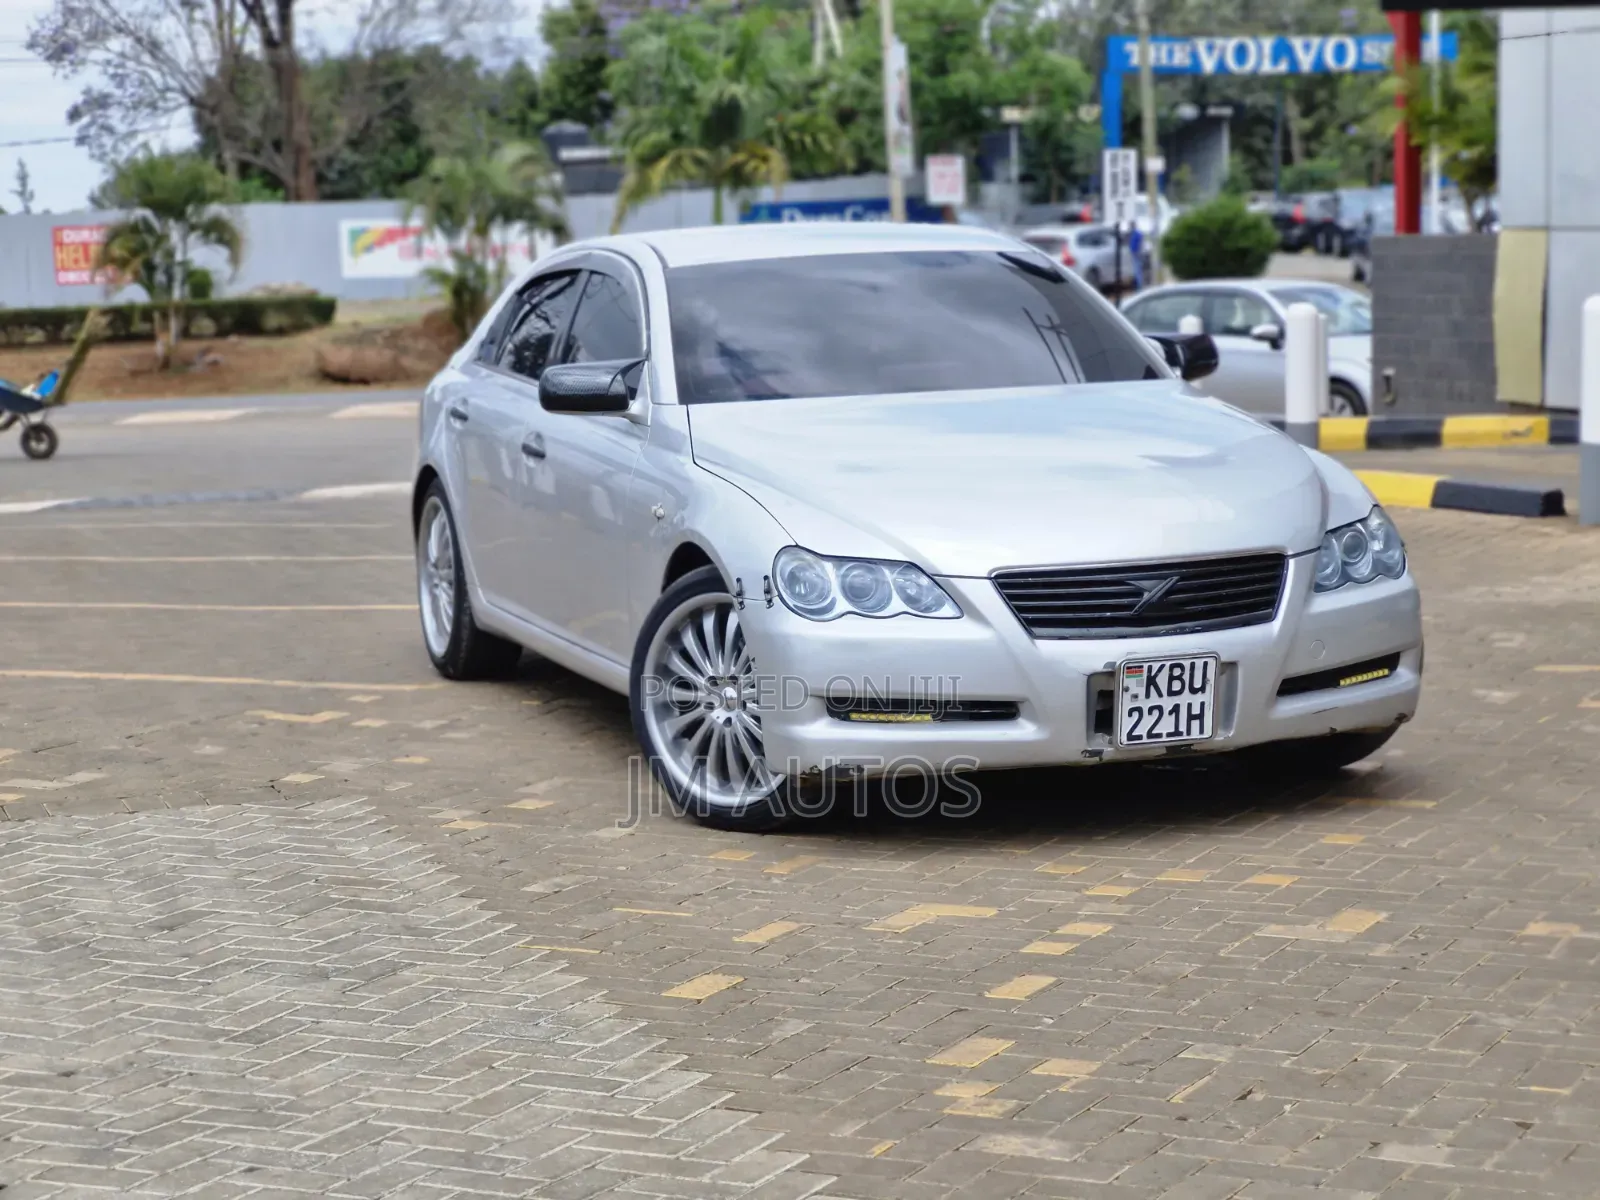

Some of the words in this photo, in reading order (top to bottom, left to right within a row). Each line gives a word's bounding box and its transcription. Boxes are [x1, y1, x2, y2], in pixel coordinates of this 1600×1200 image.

[1194, 35, 1357, 75] VOLVO
[1145, 661, 1208, 698] KBU
[1127, 701, 1205, 741] 221H
